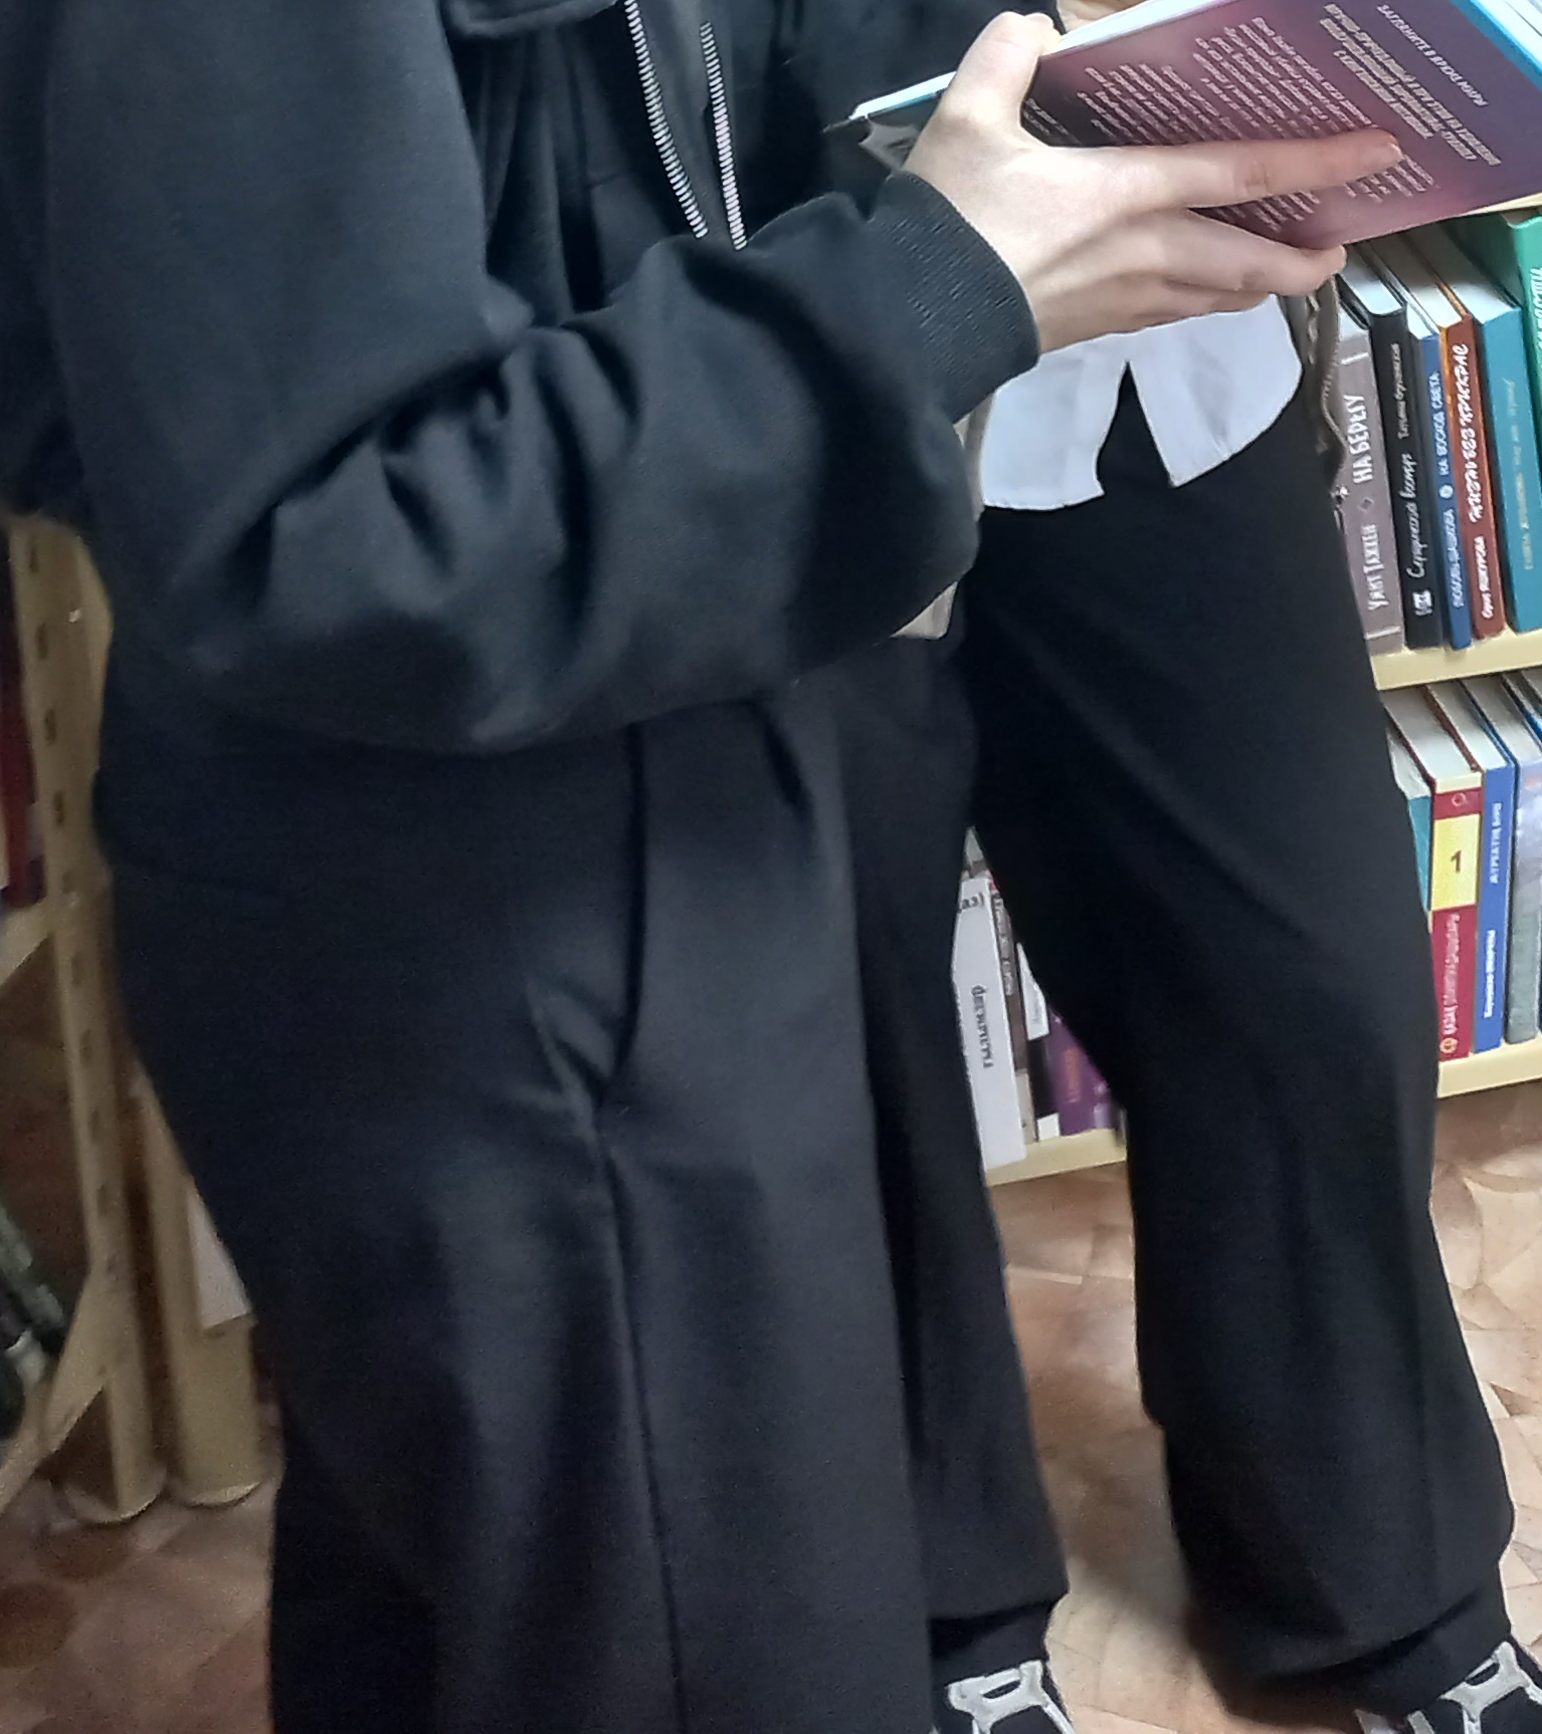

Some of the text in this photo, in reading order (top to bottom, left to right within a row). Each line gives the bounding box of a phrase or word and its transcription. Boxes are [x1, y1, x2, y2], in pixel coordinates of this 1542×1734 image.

[1427, 370, 1444, 408] СВЕТА
[1451, 342, 1476, 427] ПРИКРАС
[1432, 410, 1449, 456] ВОСХОД
[1350, 456, 1373, 482] НА
[1436, 457, 1451, 475] НА
[1449, 848, 1463, 874] 1
